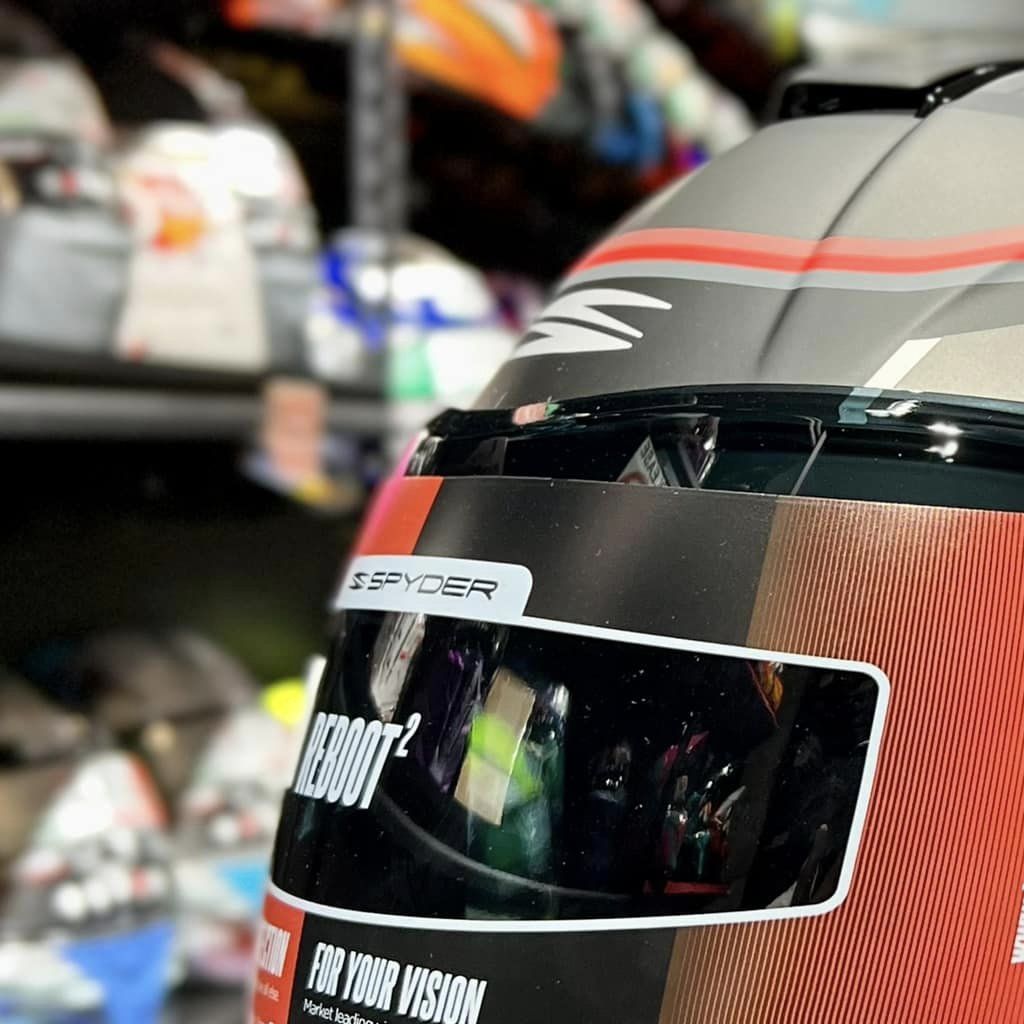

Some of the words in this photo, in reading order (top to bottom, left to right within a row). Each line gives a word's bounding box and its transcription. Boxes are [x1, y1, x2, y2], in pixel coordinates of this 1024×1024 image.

[367, 571, 499, 600] SPYDER
[306, 942, 346, 997] FOR
[342, 950, 401, 1012] YOUR
[303, 998, 333, 1021] Market
